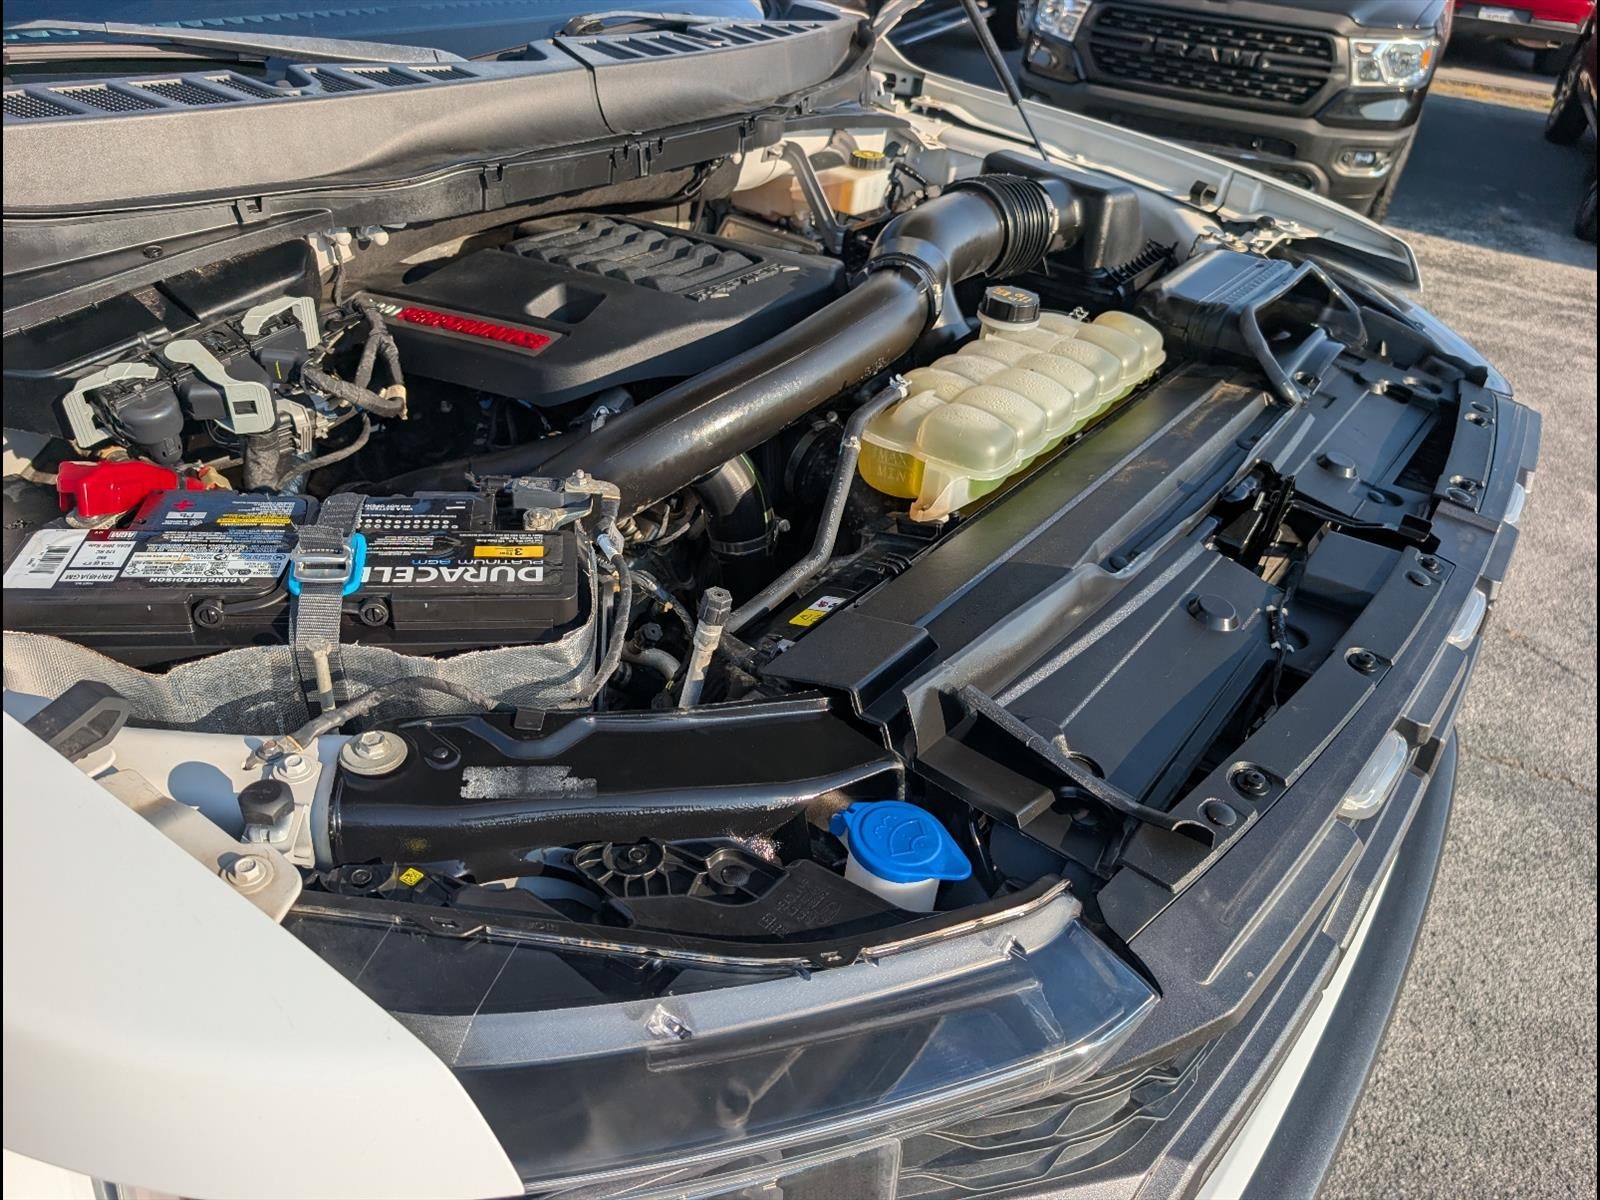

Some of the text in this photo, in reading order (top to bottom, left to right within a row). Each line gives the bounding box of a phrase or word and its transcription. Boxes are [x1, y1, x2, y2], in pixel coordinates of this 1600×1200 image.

[1155, 37, 1260, 67] RAM
[879, 448, 906, 466] MAX
[879, 463, 906, 482] MIN
[514, 547, 523, 556] 3
